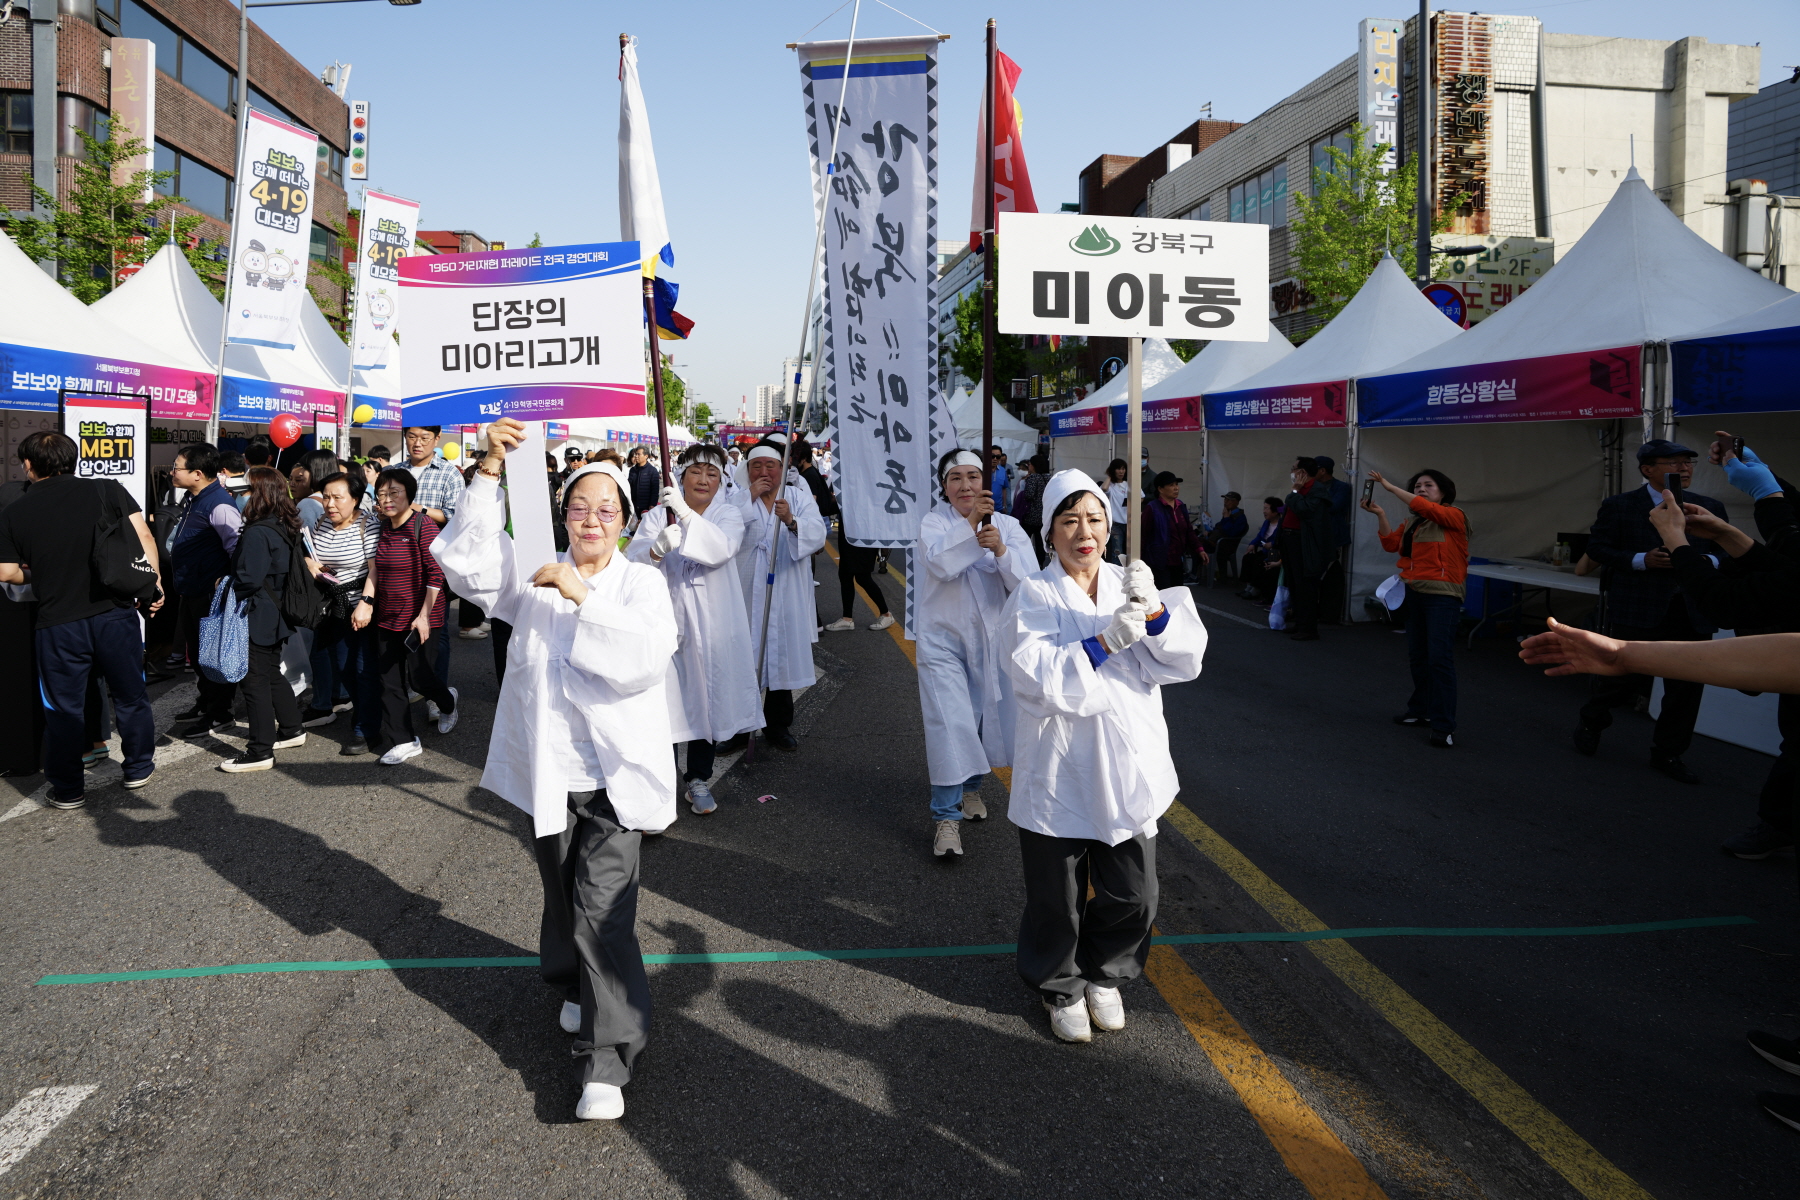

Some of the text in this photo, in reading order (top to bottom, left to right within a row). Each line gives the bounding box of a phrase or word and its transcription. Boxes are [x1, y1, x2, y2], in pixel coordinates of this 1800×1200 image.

[116, 44, 143, 62] 수유
[1373, 30, 1398, 89] 리치
[268, 149, 304, 173] 보보와
[253, 161, 309, 189] 함께 떠나는
[255, 208, 299, 233] 대모험
[378, 218, 406, 235] 보보와
[370, 229, 386, 242] 함께
[1131, 231, 1215, 255] 강북구
[428, 251, 609, 273] 1960 거리재현 퍼레이드 전국 경연대회
[1509, 258, 1532, 276] 2F
[1032, 270, 1241, 328] 미아동
[472, 297, 566, 332] 단장의
[441, 335, 601, 373] 미아리고개
[11, 370, 62, 392] 보보와
[64, 375, 93, 397] 함께
[1427, 378, 1518, 406] 합동상황실
[238, 394, 264, 410] 보보와
[264, 397, 280, 411] 함께
[280, 398, 301, 413] 떠나는
[1154, 407, 1180, 421] 소방본부
[1224, 396, 1313, 417] 합동상황실 경찰본부
[80, 422, 134, 437] 보보와 함께
[81, 438, 133, 459] MBTI
[80, 459, 133, 475] 알아보기
